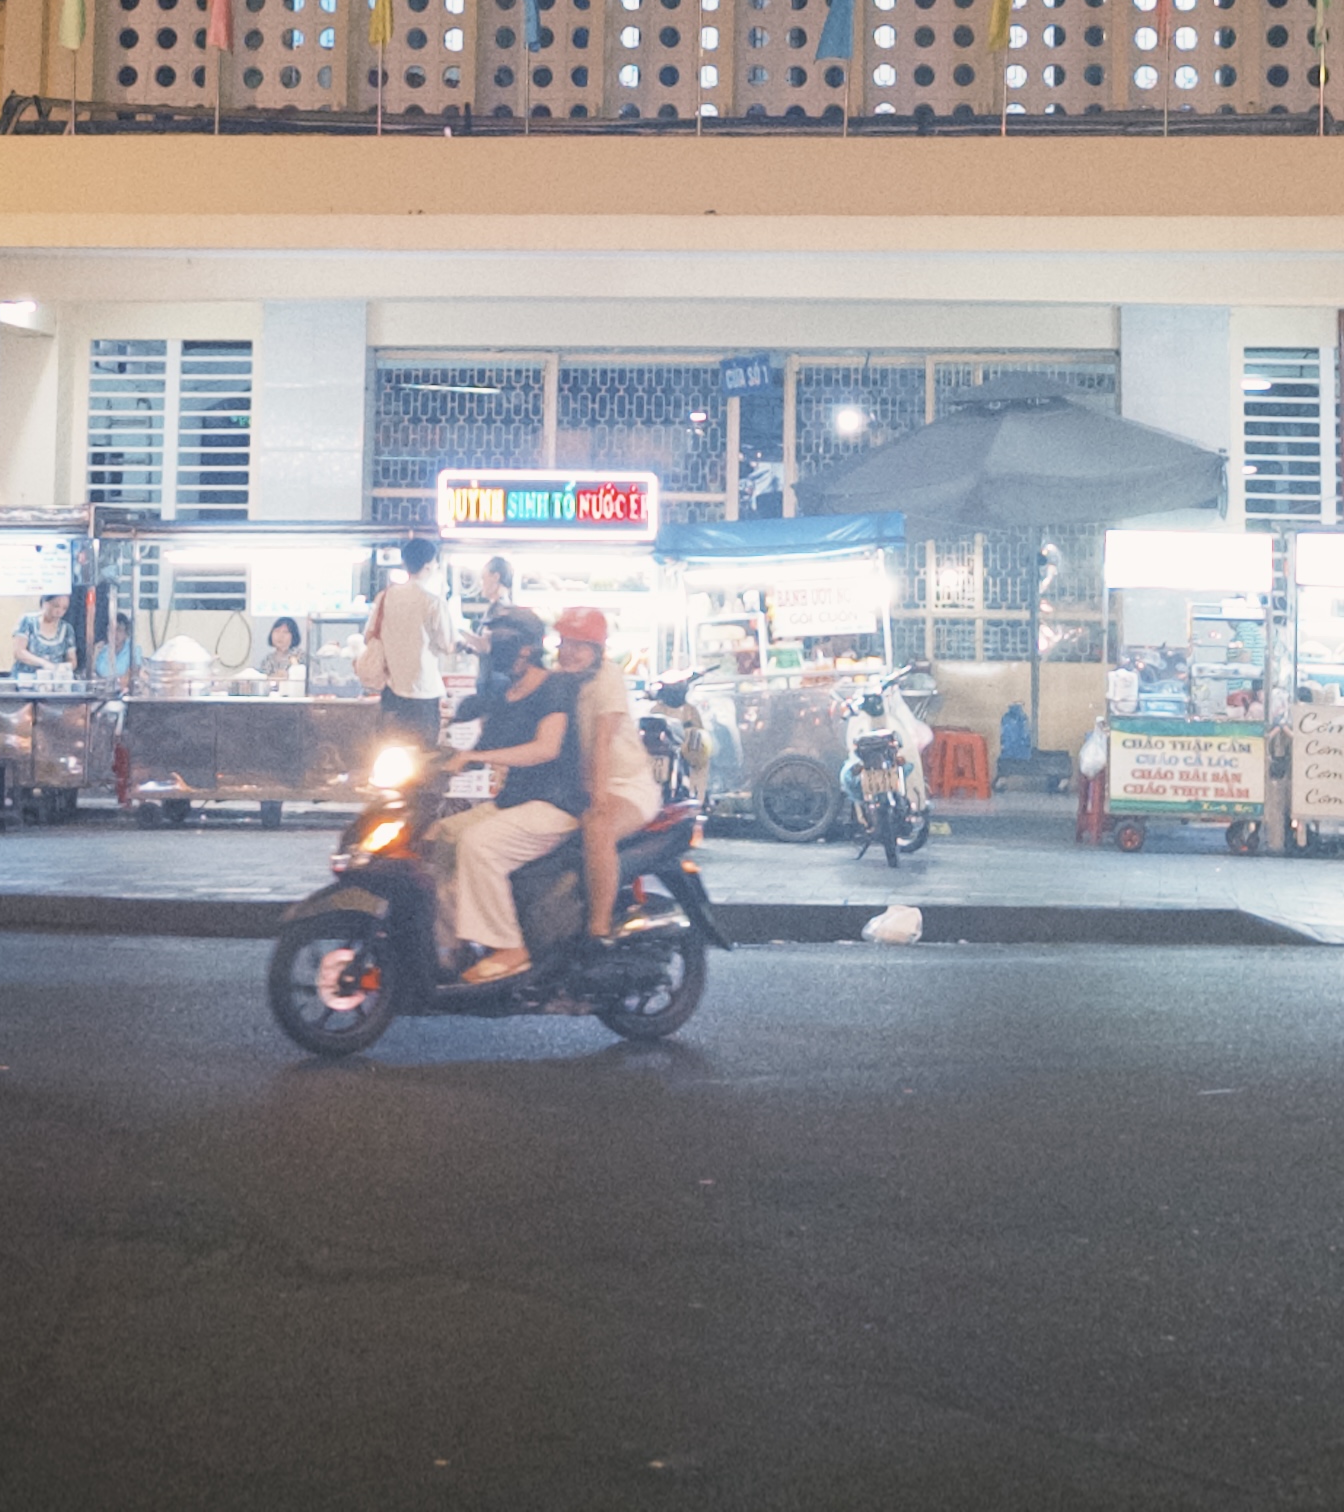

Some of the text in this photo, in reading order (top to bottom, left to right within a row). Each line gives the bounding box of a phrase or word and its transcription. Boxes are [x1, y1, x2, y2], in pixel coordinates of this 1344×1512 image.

[507, 490, 550, 522] SINH
[550, 480, 577, 521] TỐ
[577, 481, 627, 523] NƯỚC
